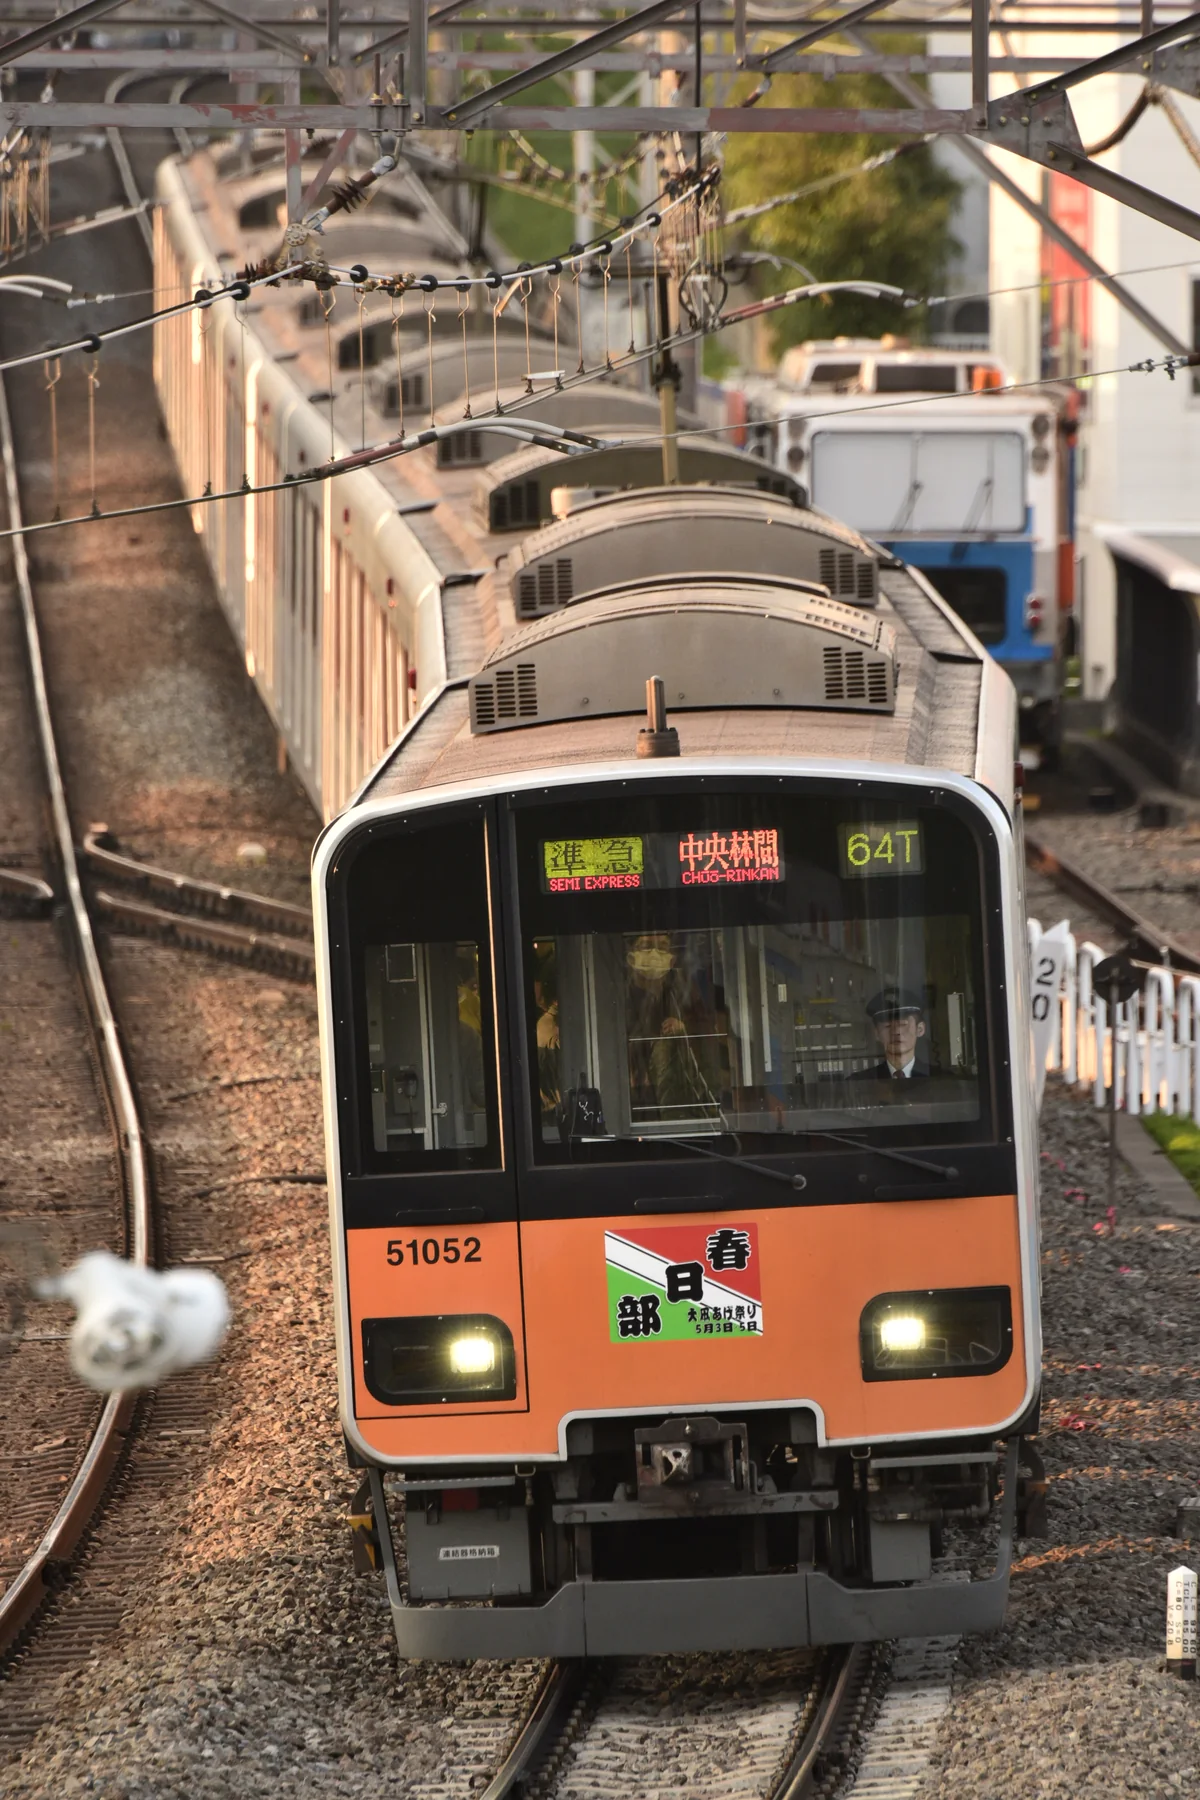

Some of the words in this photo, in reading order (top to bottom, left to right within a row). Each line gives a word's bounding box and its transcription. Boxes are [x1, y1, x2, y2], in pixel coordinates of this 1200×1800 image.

[550, 840, 638, 875] 準急
[679, 829, 779, 871] 中央林間
[848, 830, 918, 866] 64T
[549, 878, 580, 892] SEMI
[584, 874, 640, 890] EXPRESS
[386, 1236, 482, 1266] 51052
